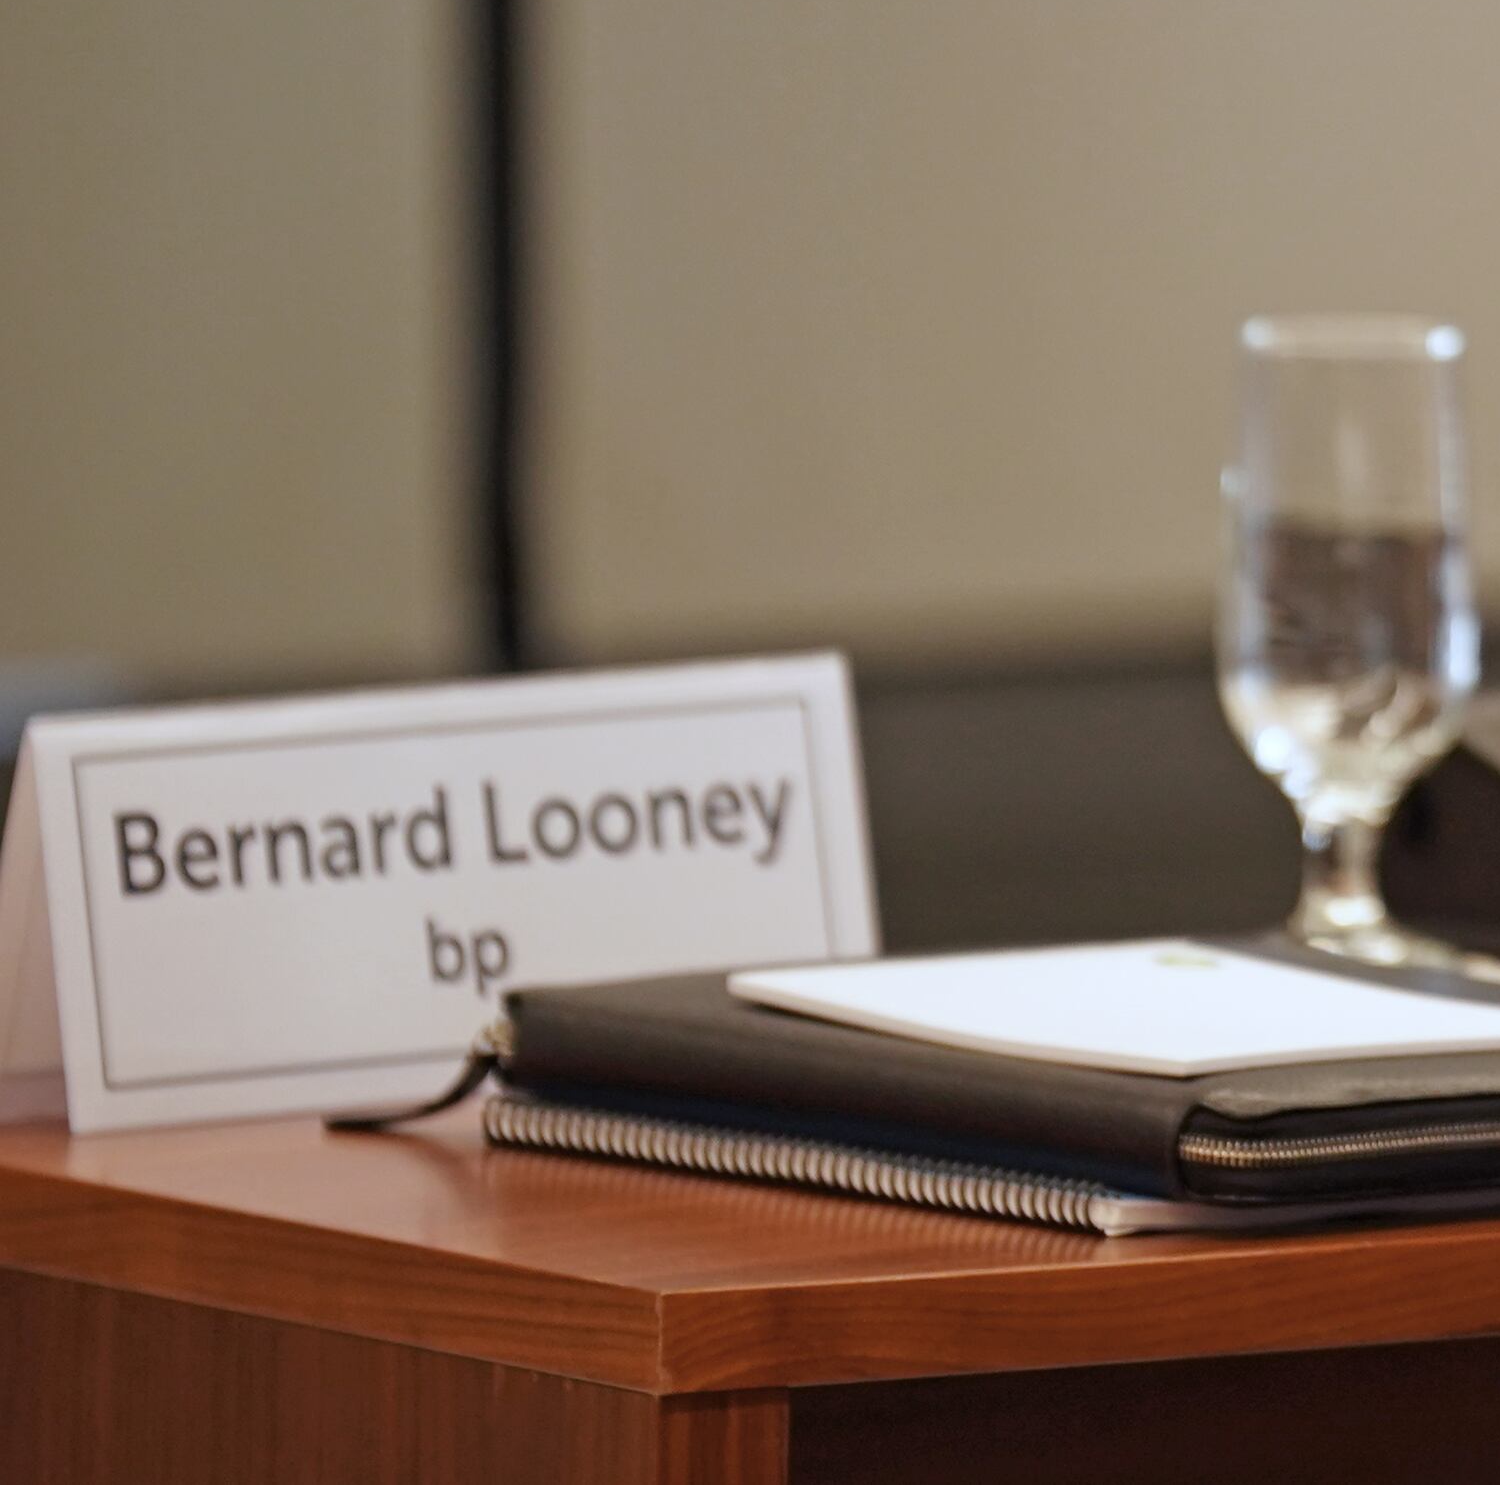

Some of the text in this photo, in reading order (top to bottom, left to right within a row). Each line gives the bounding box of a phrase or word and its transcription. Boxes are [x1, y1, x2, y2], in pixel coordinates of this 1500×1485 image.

[112, 775, 796, 898] Bernard Looney
[426, 915, 512, 994] bp
